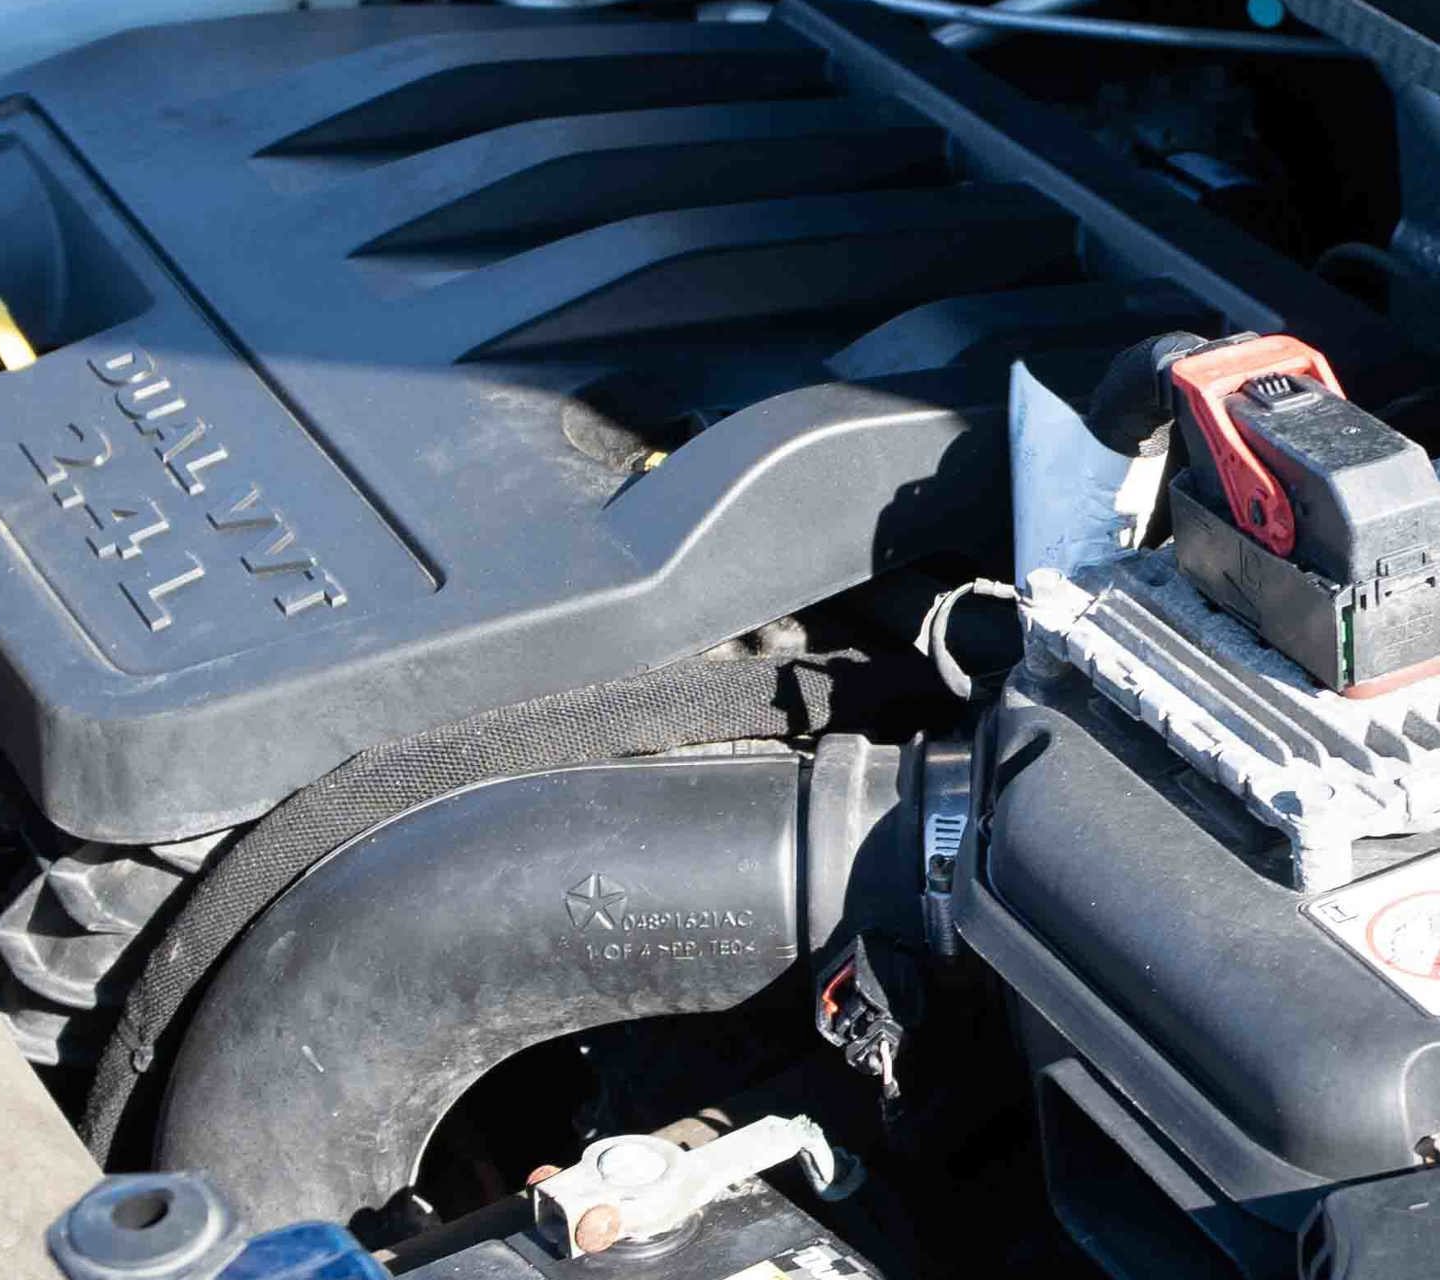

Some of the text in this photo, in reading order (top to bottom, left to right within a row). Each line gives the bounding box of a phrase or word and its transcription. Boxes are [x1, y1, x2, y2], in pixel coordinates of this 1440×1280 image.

[18, 420, 206, 632] 2.4L
[87, 348, 348, 618] DUAL VVT
